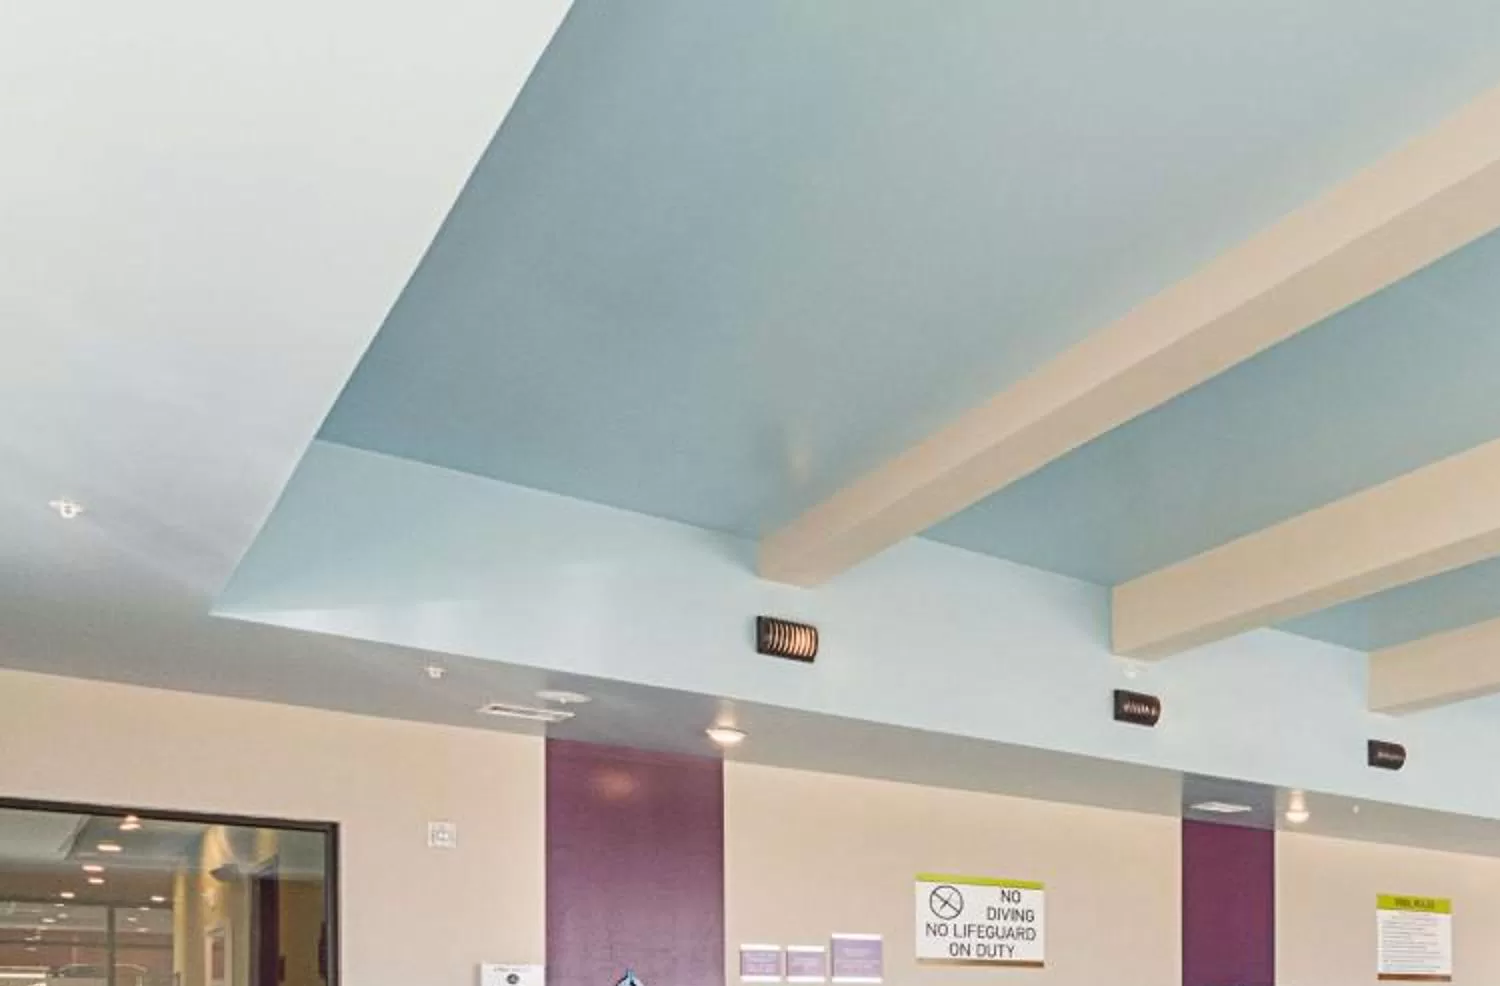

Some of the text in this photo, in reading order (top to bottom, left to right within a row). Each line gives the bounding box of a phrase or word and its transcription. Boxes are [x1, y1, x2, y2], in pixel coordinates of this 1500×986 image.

[1000, 889, 1021, 904] NO
[986, 906, 1035, 923] DIVING
[925, 923, 1037, 941] NO LIFEGUARD
[949, 942, 1015, 958] ON DUTY
